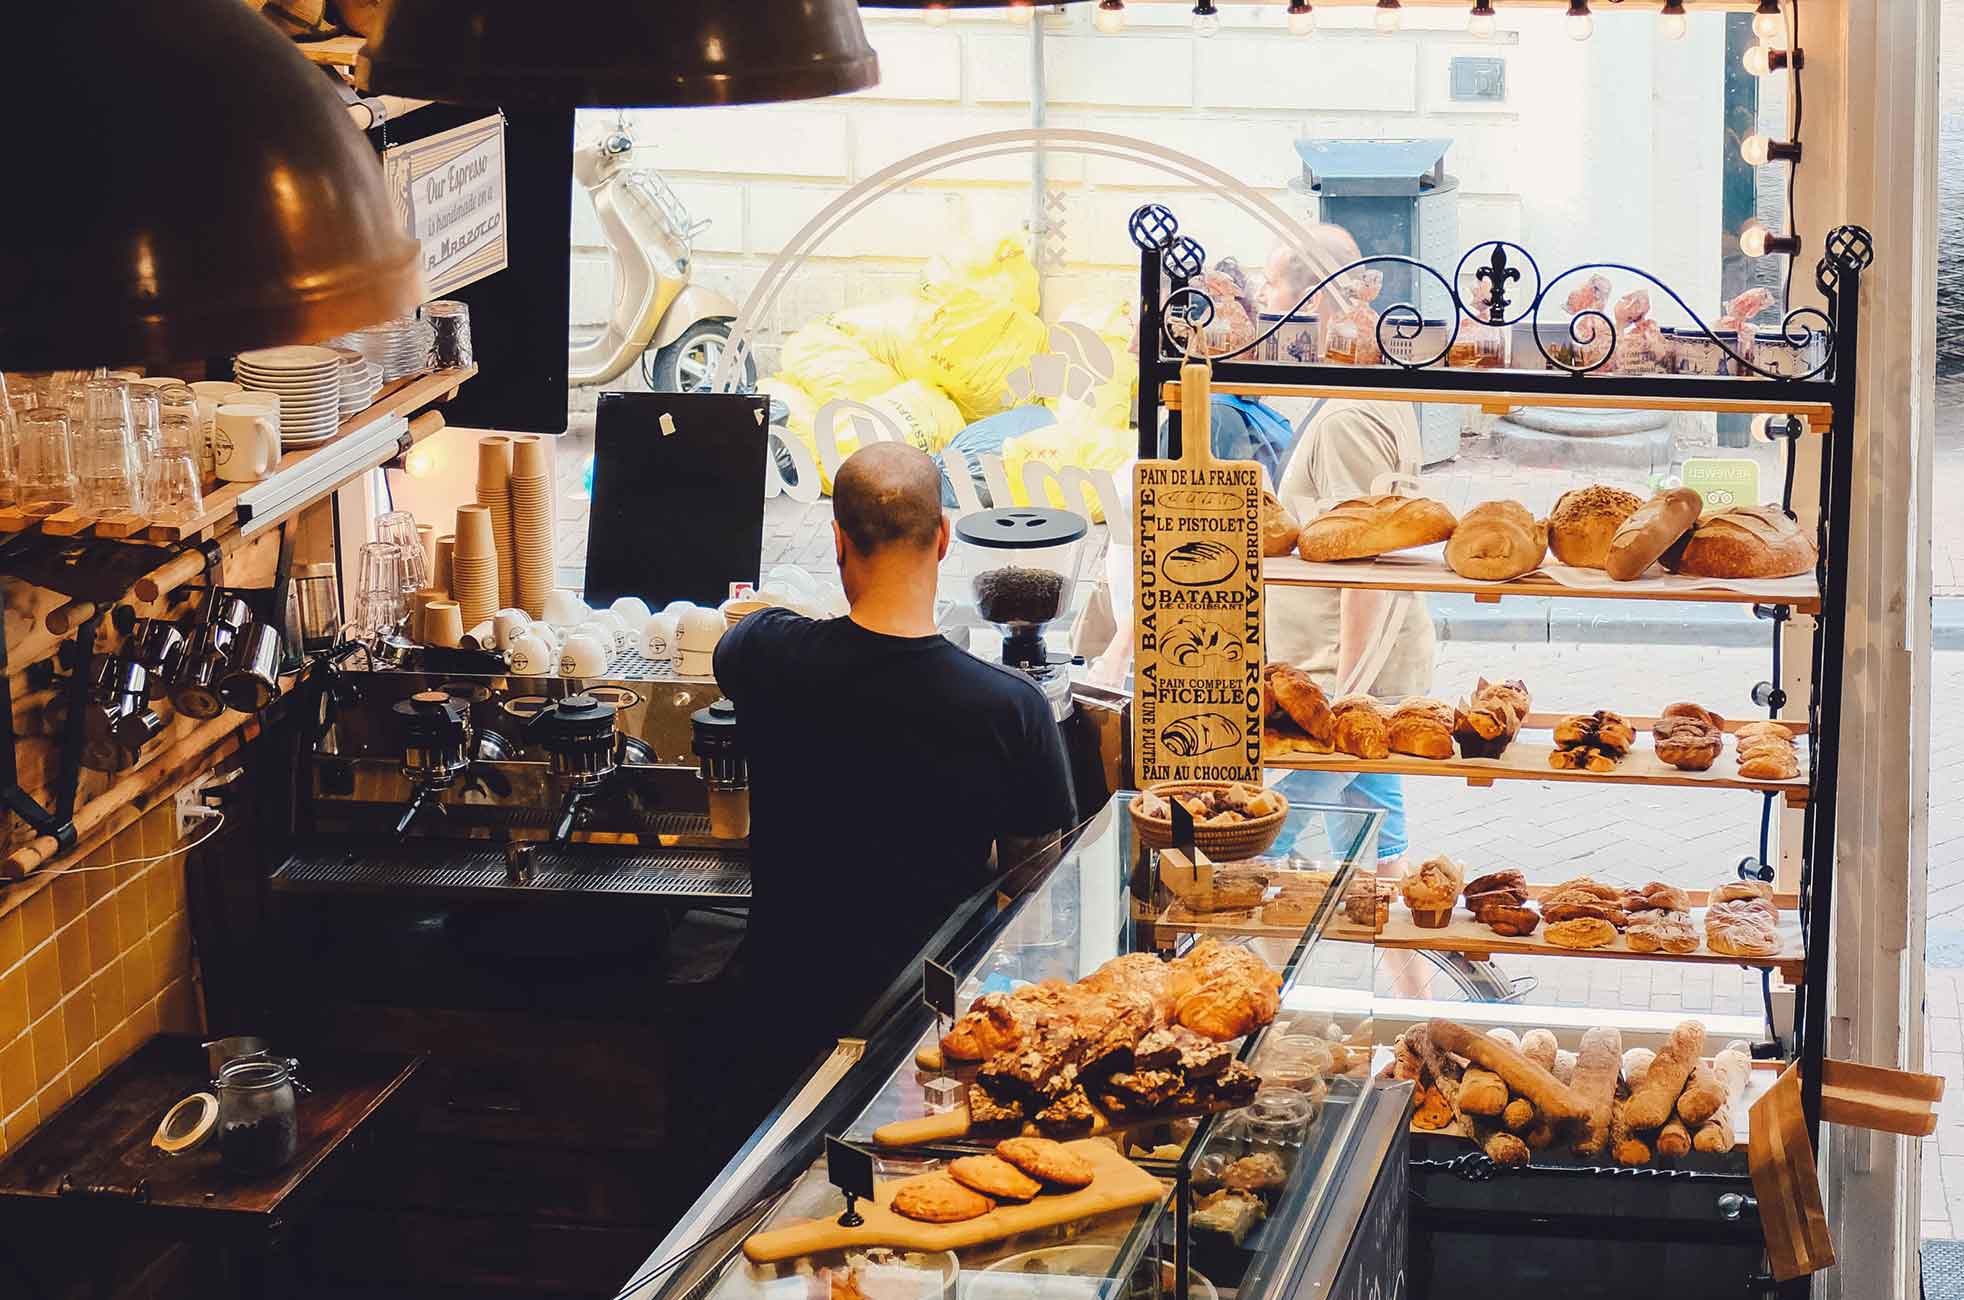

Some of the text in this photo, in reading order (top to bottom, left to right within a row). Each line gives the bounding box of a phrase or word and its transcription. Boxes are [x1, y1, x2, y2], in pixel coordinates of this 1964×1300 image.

[426, 154, 488, 205] Our Espresso
[1140, 469, 1257, 486] PAIN DE LA FRANCE
[1157, 517, 1246, 533] LE PISTOLET
[1246, 487, 1259, 560] BRIOCHE
[1140, 488, 1157, 701] LA BAGUETTE
[1159, 590, 1245, 604] BATARD
[1245, 560, 1261, 766] PAIN ROND
[1159, 678, 1244, 689] PAIN COMPLET
[1158, 688, 1245, 705] FICELLE
[1142, 701, 1156, 765] UNE FLUTE
[1142, 765, 1260, 782] PAIN AU CHOCOLAT
